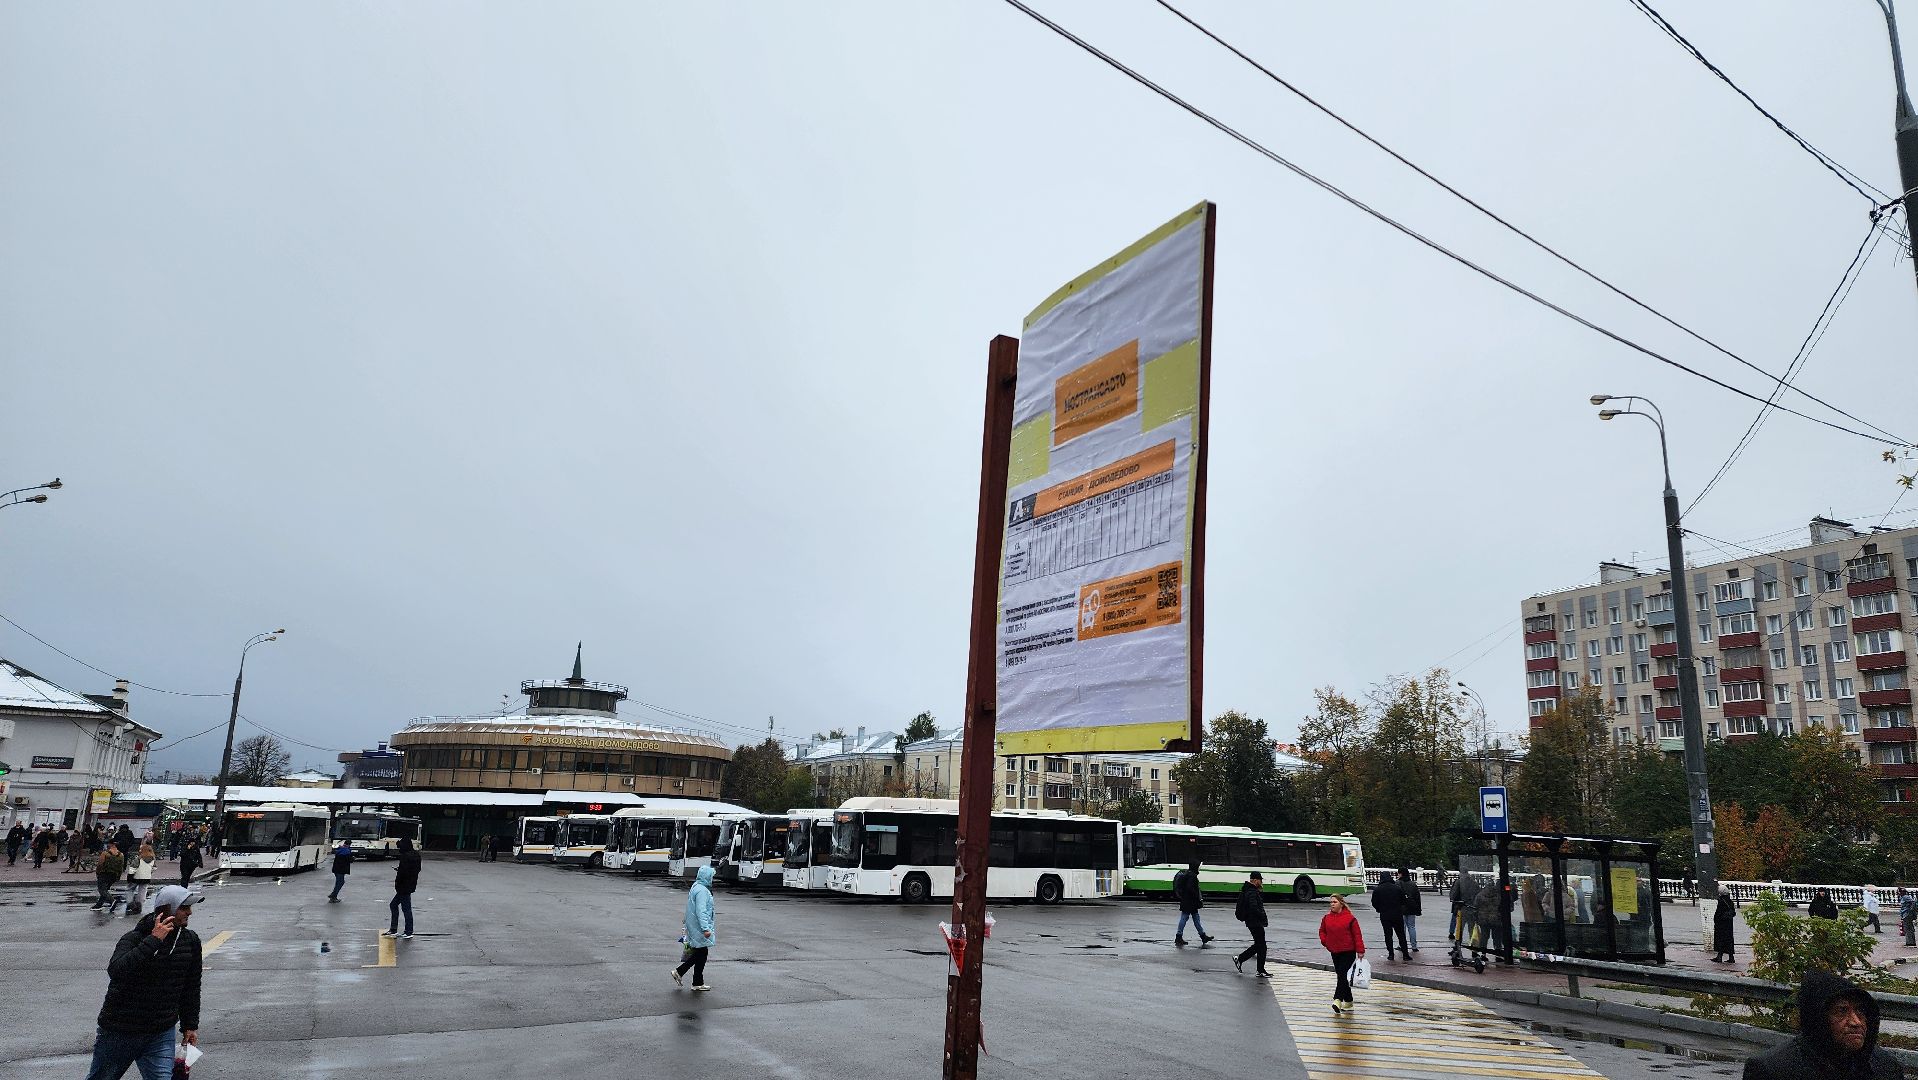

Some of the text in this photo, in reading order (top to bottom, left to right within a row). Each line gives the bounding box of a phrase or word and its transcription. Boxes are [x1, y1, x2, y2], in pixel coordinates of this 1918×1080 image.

[1058, 464, 1140, 500] СТАНЦИЯ ДОМОДЕДОВО
[535, 736, 660, 751] АВТОВОКЗАЛ ДОМОДЕДОВО
